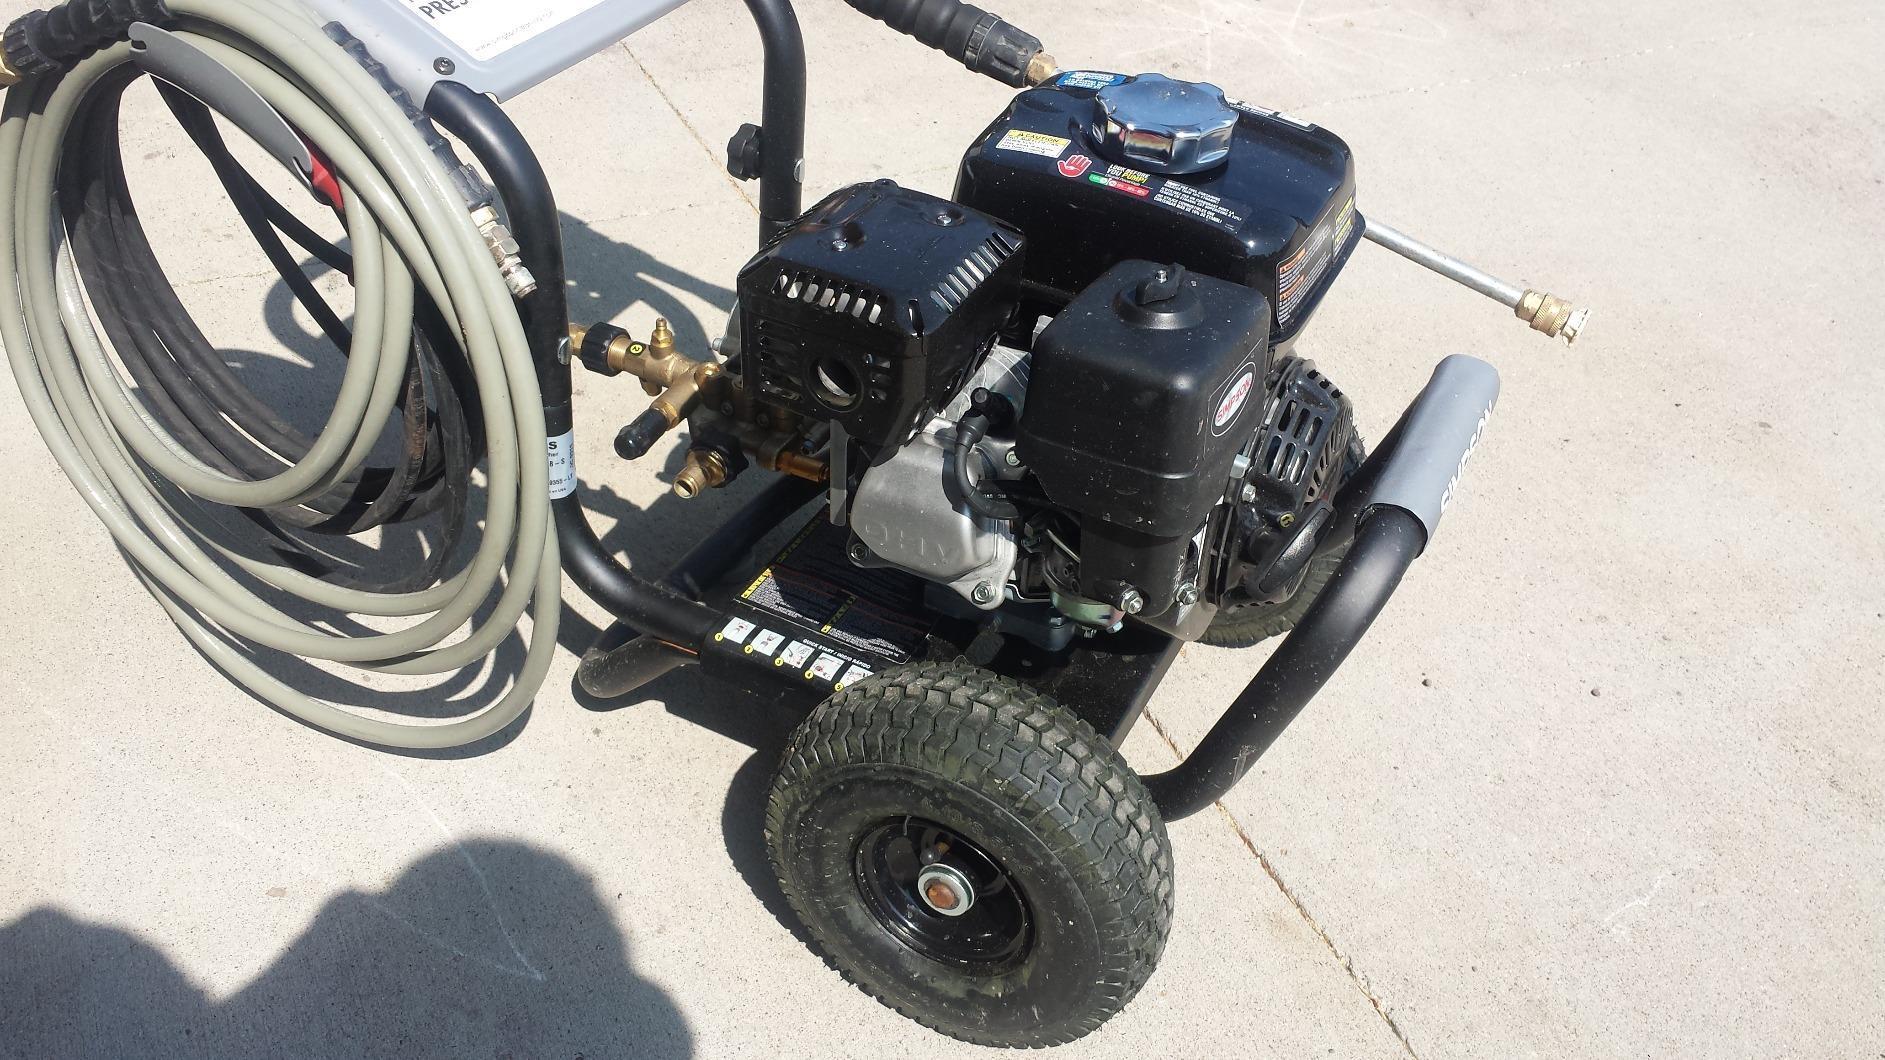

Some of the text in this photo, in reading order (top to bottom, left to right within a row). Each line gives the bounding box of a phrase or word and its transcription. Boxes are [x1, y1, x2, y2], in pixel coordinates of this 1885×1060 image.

[1025, 133, 1060, 143] CAUTION
[1106, 167, 1122, 176] YOU
[1121, 172, 1149, 183] PUMP!
[1109, 164, 1150, 179] LOOK BEFORE
[1216, 378, 1250, 421] SIMPSON
[803, 639, 818, 648] QUICK
[818, 645, 834, 654] START
